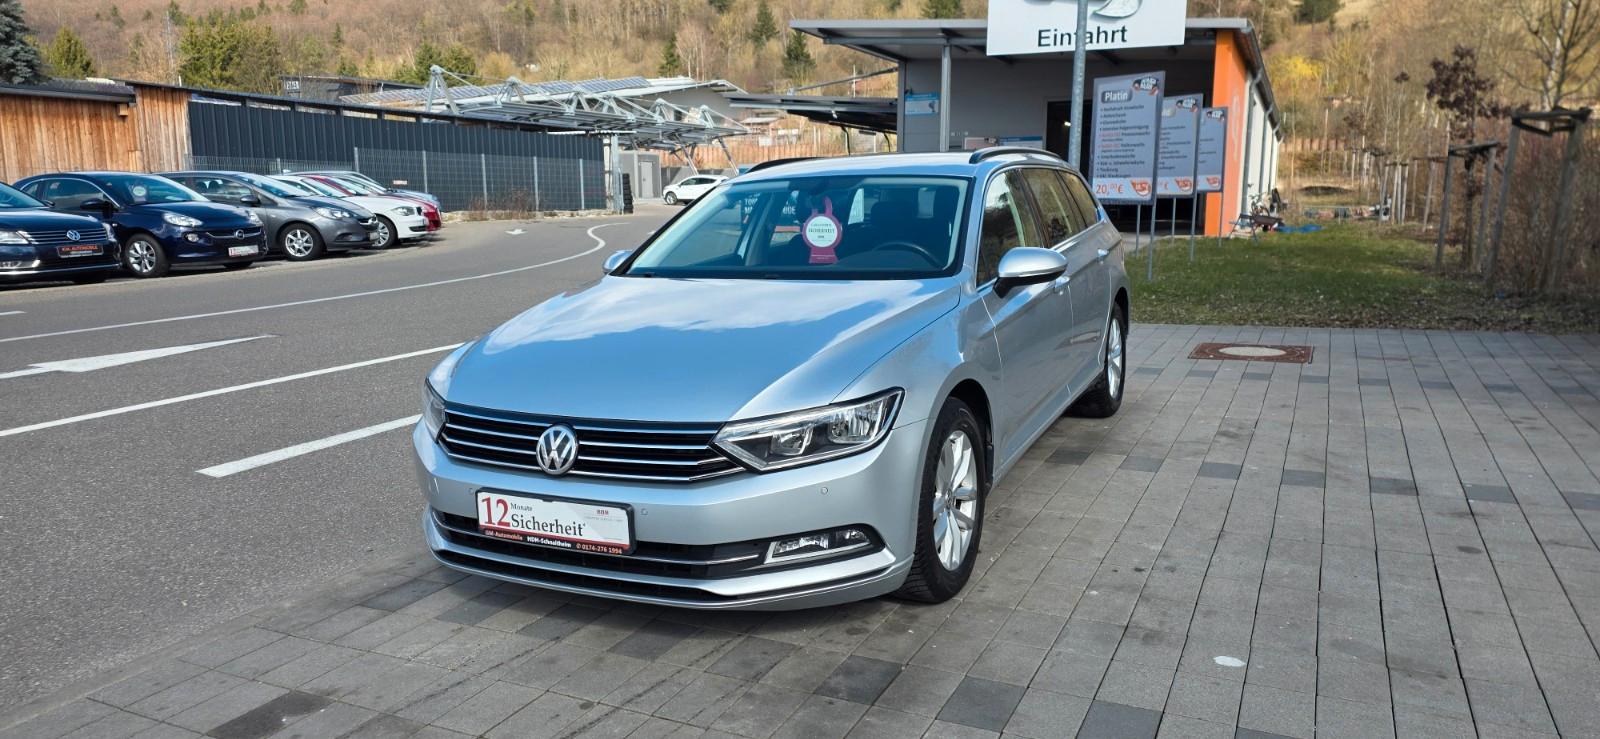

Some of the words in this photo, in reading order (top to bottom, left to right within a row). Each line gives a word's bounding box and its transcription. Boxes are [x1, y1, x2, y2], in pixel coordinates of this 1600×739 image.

[1037, 25, 1128, 47] Einahrt
[1104, 91, 1129, 101] Platin
[481, 496, 511, 528] 12
[510, 503, 533, 511] Monate
